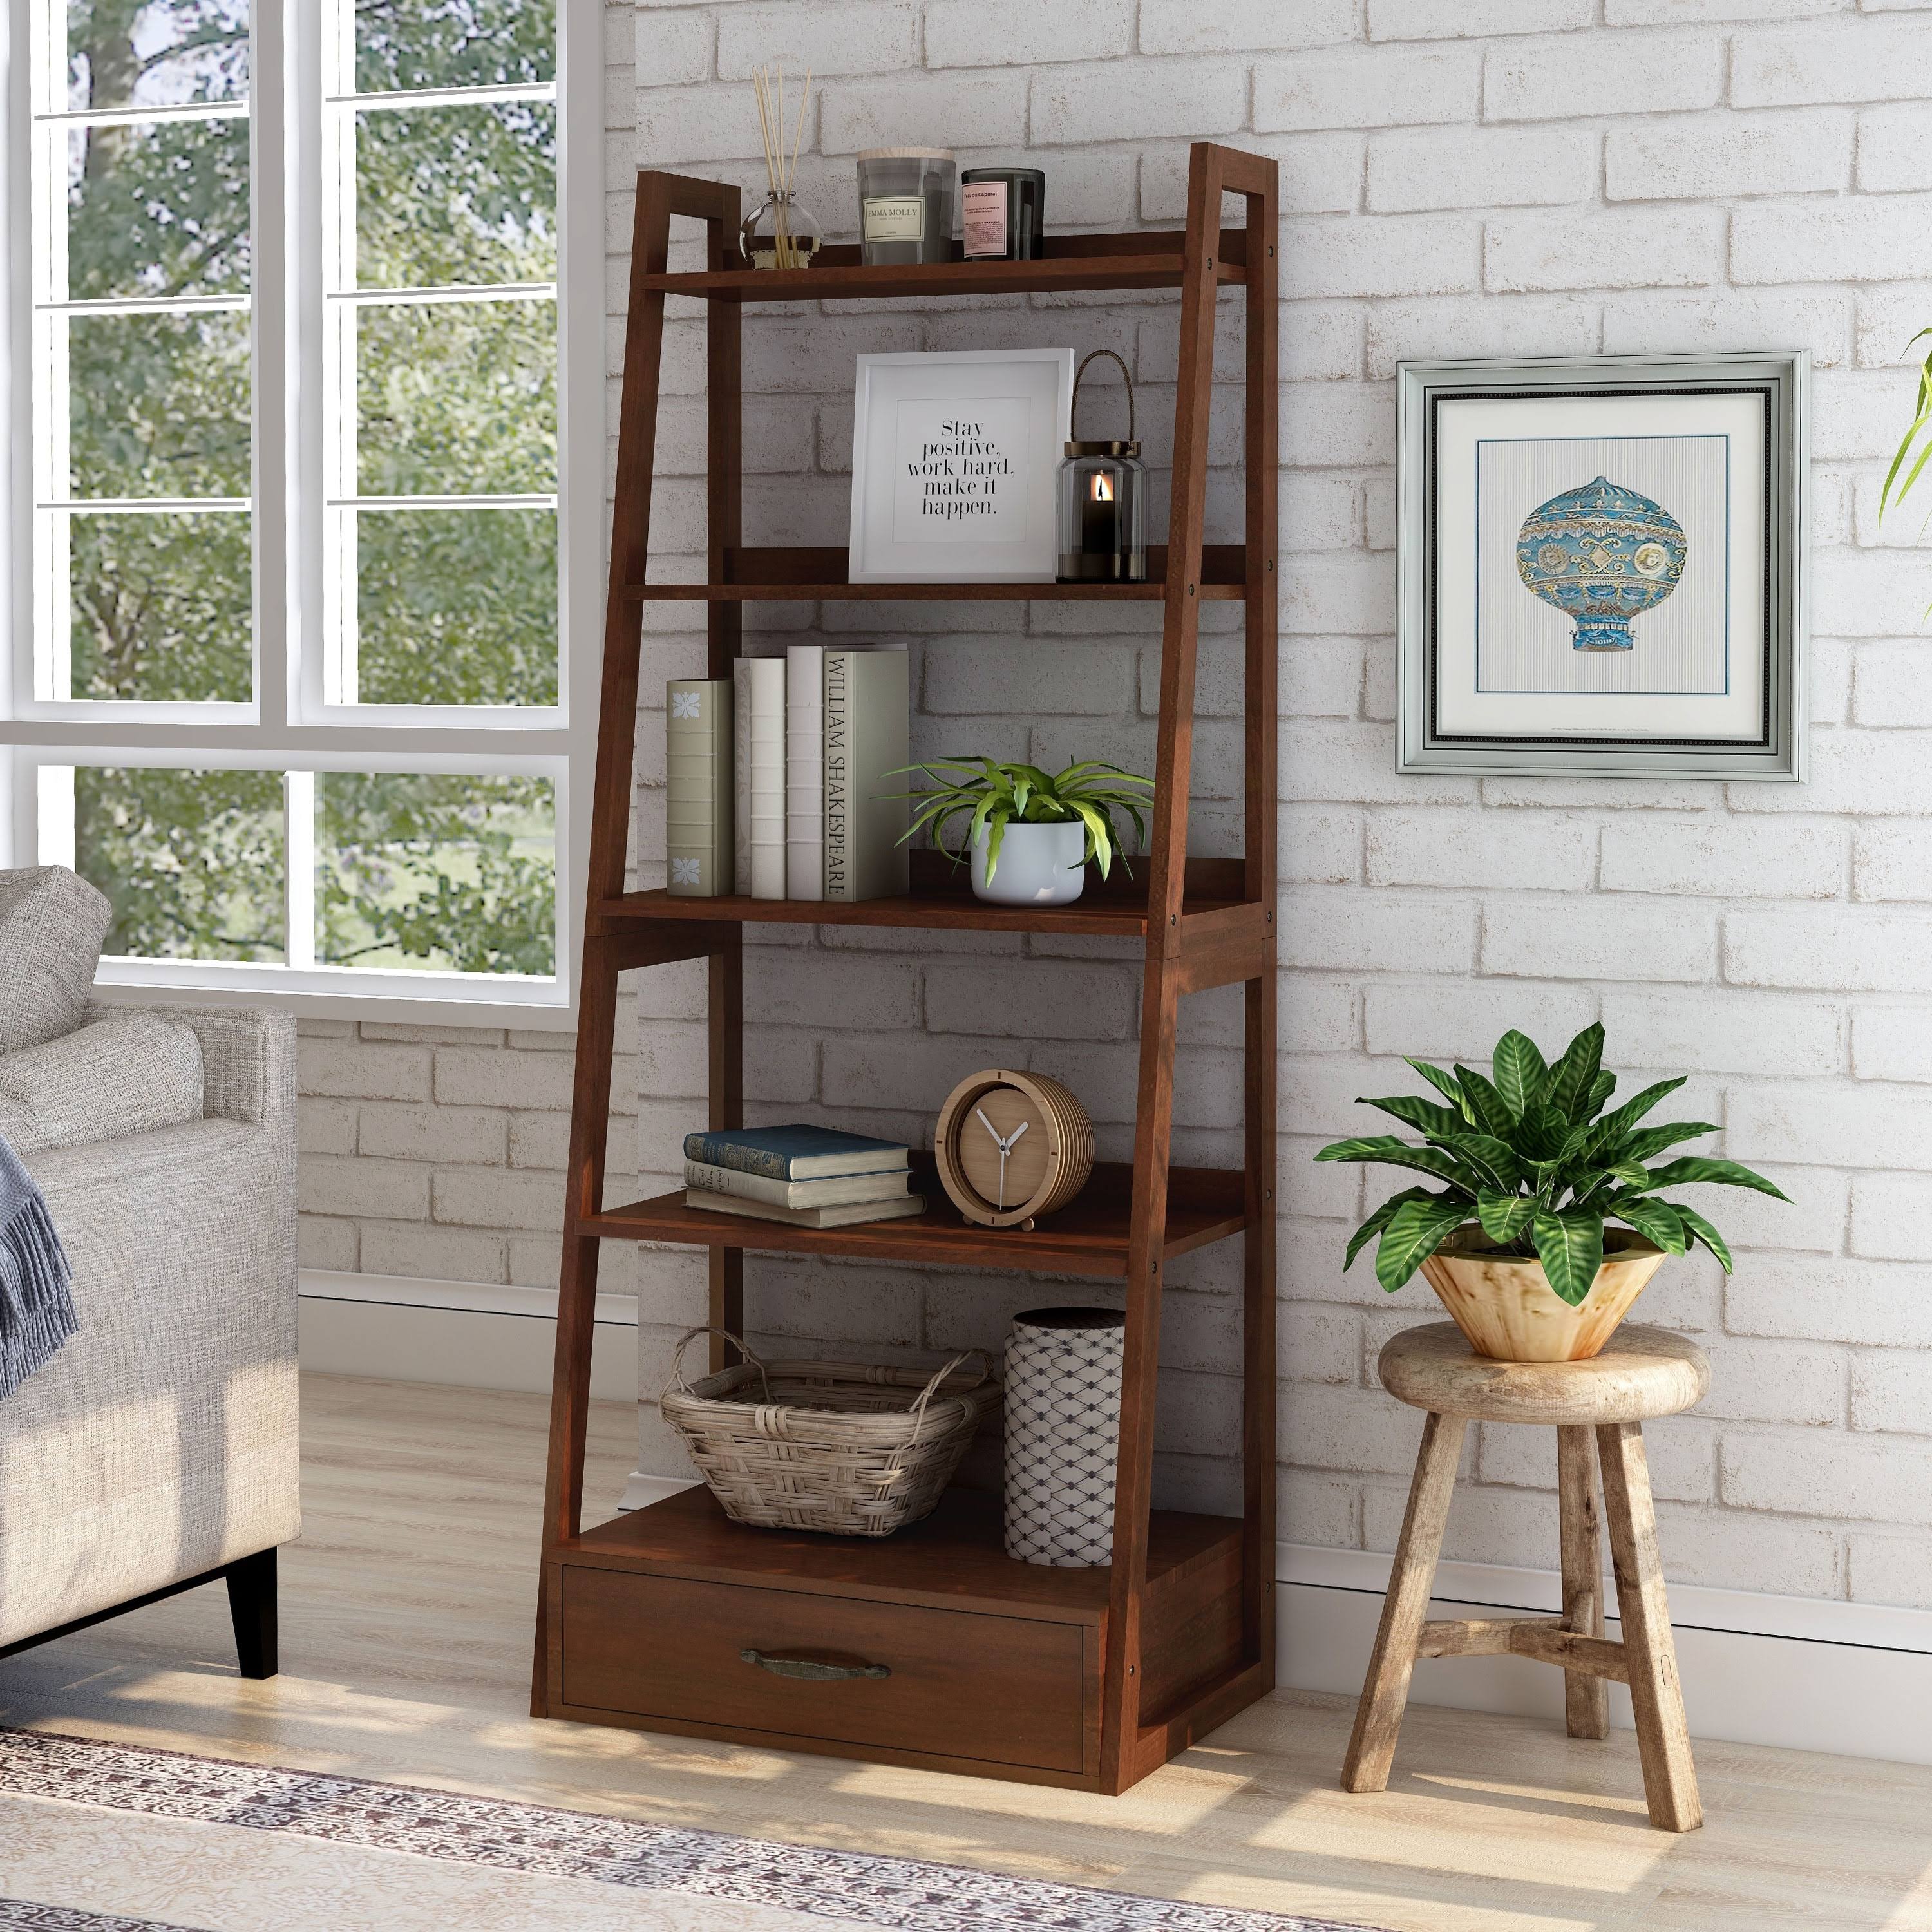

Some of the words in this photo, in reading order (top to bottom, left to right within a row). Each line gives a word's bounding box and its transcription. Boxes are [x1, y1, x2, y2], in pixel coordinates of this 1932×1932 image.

[942, 419, 984, 439] Stay
[923, 438, 1001, 461] positive,
[907, 459, 954, 476] work
[963, 458, 1015, 478] hard,
[924, 478, 977, 495] make
[984, 477, 998, 495] it
[923, 498, 998, 520] happen.
[828, 656, 845, 749] WILLIAM
[828, 755, 845, 895] SHAKESPEARE
